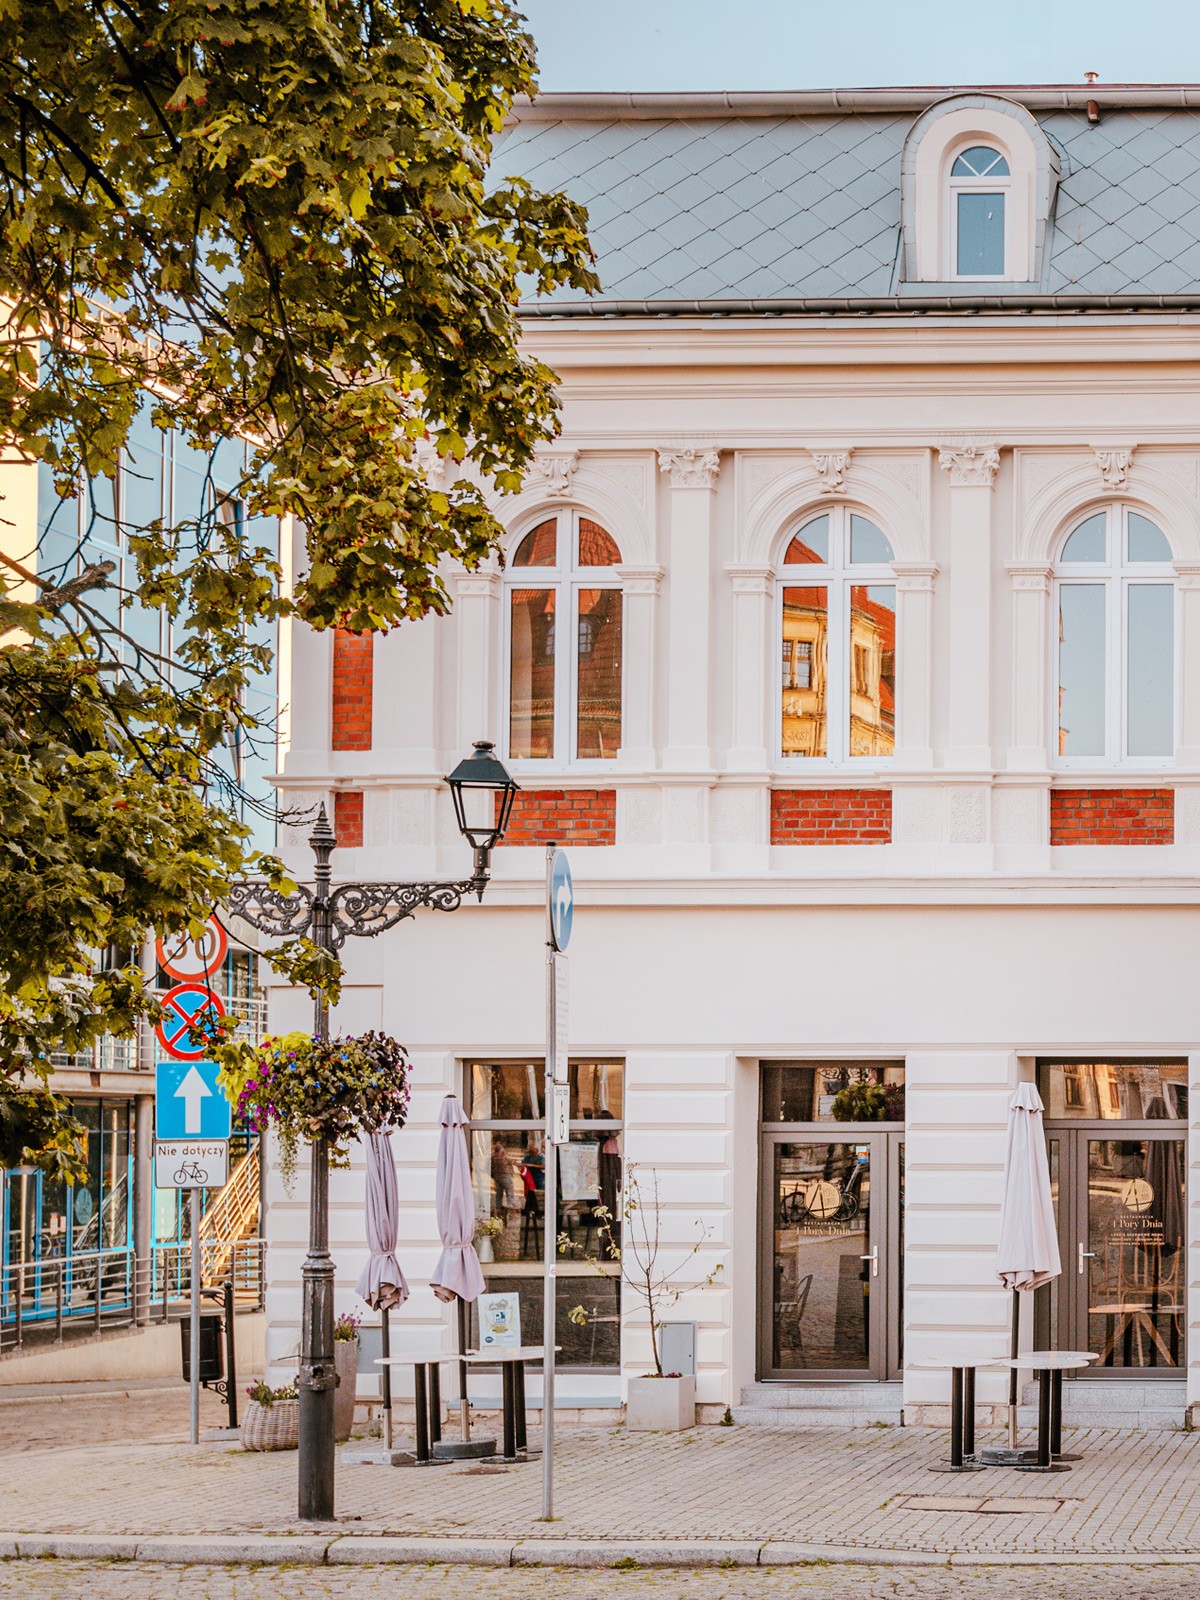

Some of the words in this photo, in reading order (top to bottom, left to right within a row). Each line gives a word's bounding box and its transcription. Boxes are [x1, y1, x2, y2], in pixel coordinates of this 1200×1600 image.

[167, 927, 216, 960] 30
[158, 1145, 177, 1156] Nie
[182, 1145, 224, 1158] dotyczy
[1119, 1219, 1140, 1230] Pory
[1142, 1219, 1163, 1228] Dnia
[804, 1226, 825, 1238] Pory
[828, 1226, 851, 1235] Dnia
